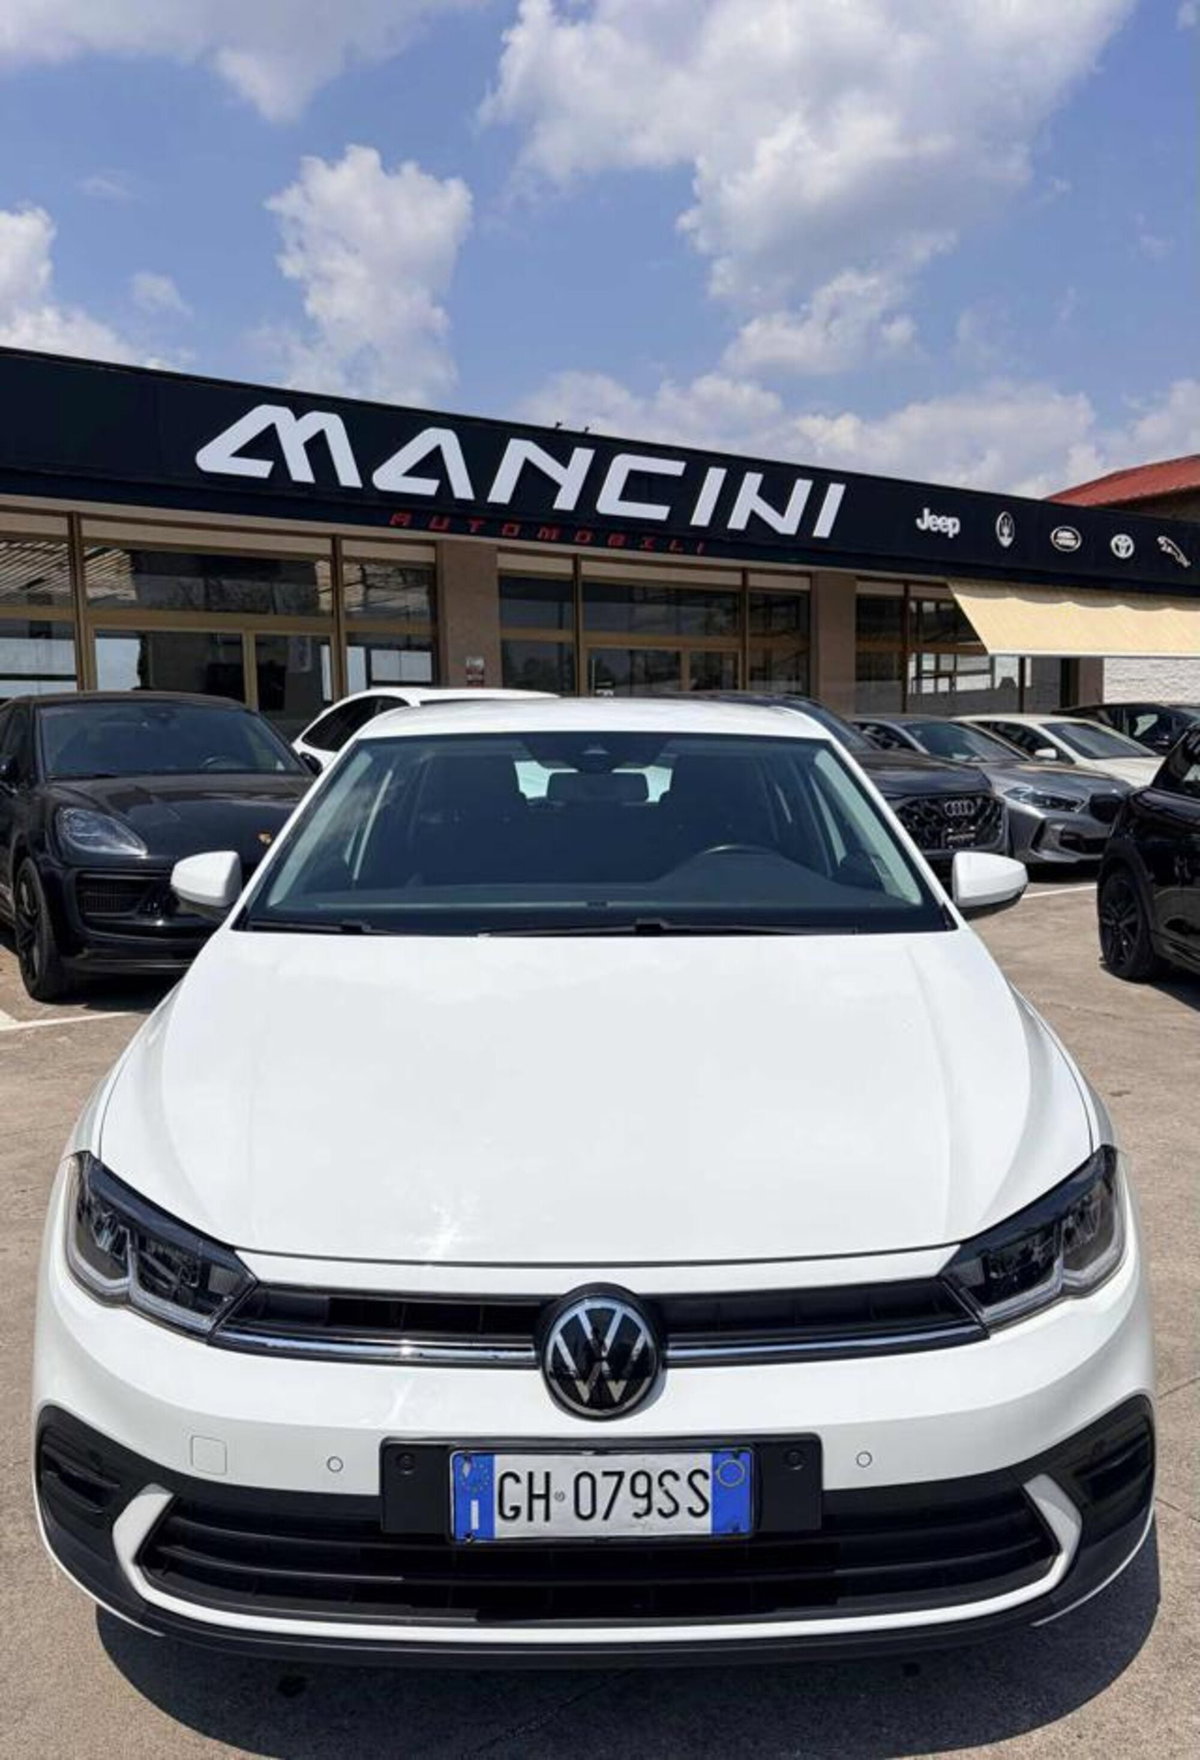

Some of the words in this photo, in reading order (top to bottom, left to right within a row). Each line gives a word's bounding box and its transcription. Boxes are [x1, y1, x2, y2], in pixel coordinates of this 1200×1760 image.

[195, 404, 846, 538] MANCINI
[389, 511, 705, 555] AUTOMOBILI
[916, 507, 961, 538] Jeep
[497, 1470, 551, 1522] GH
[573, 1469, 710, 1521] 079SS
